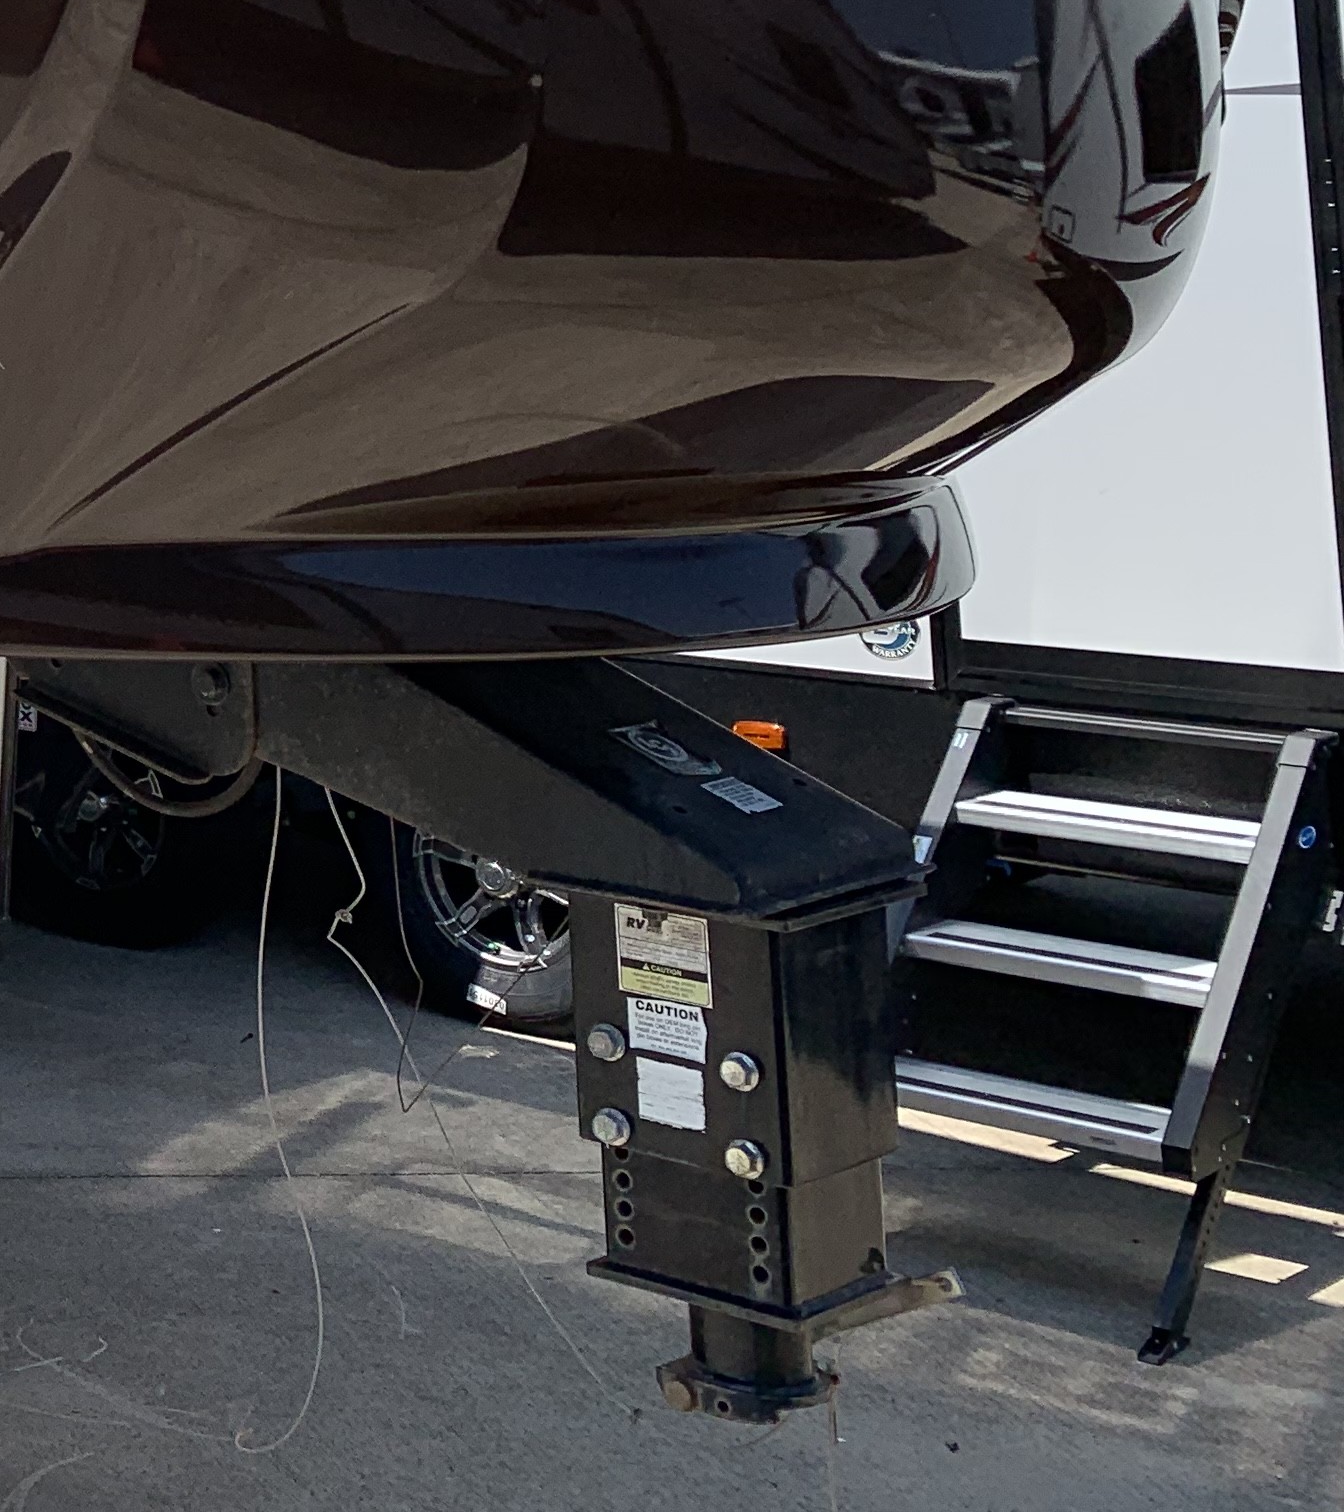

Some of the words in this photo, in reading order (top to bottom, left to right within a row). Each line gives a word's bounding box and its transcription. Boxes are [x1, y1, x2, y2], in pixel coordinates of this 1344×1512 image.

[872, 640, 916, 657] WARRANTY
[626, 917, 645, 929] RV
[651, 965, 682, 976] CAUTION
[636, 1000, 699, 1022] CAUTION
